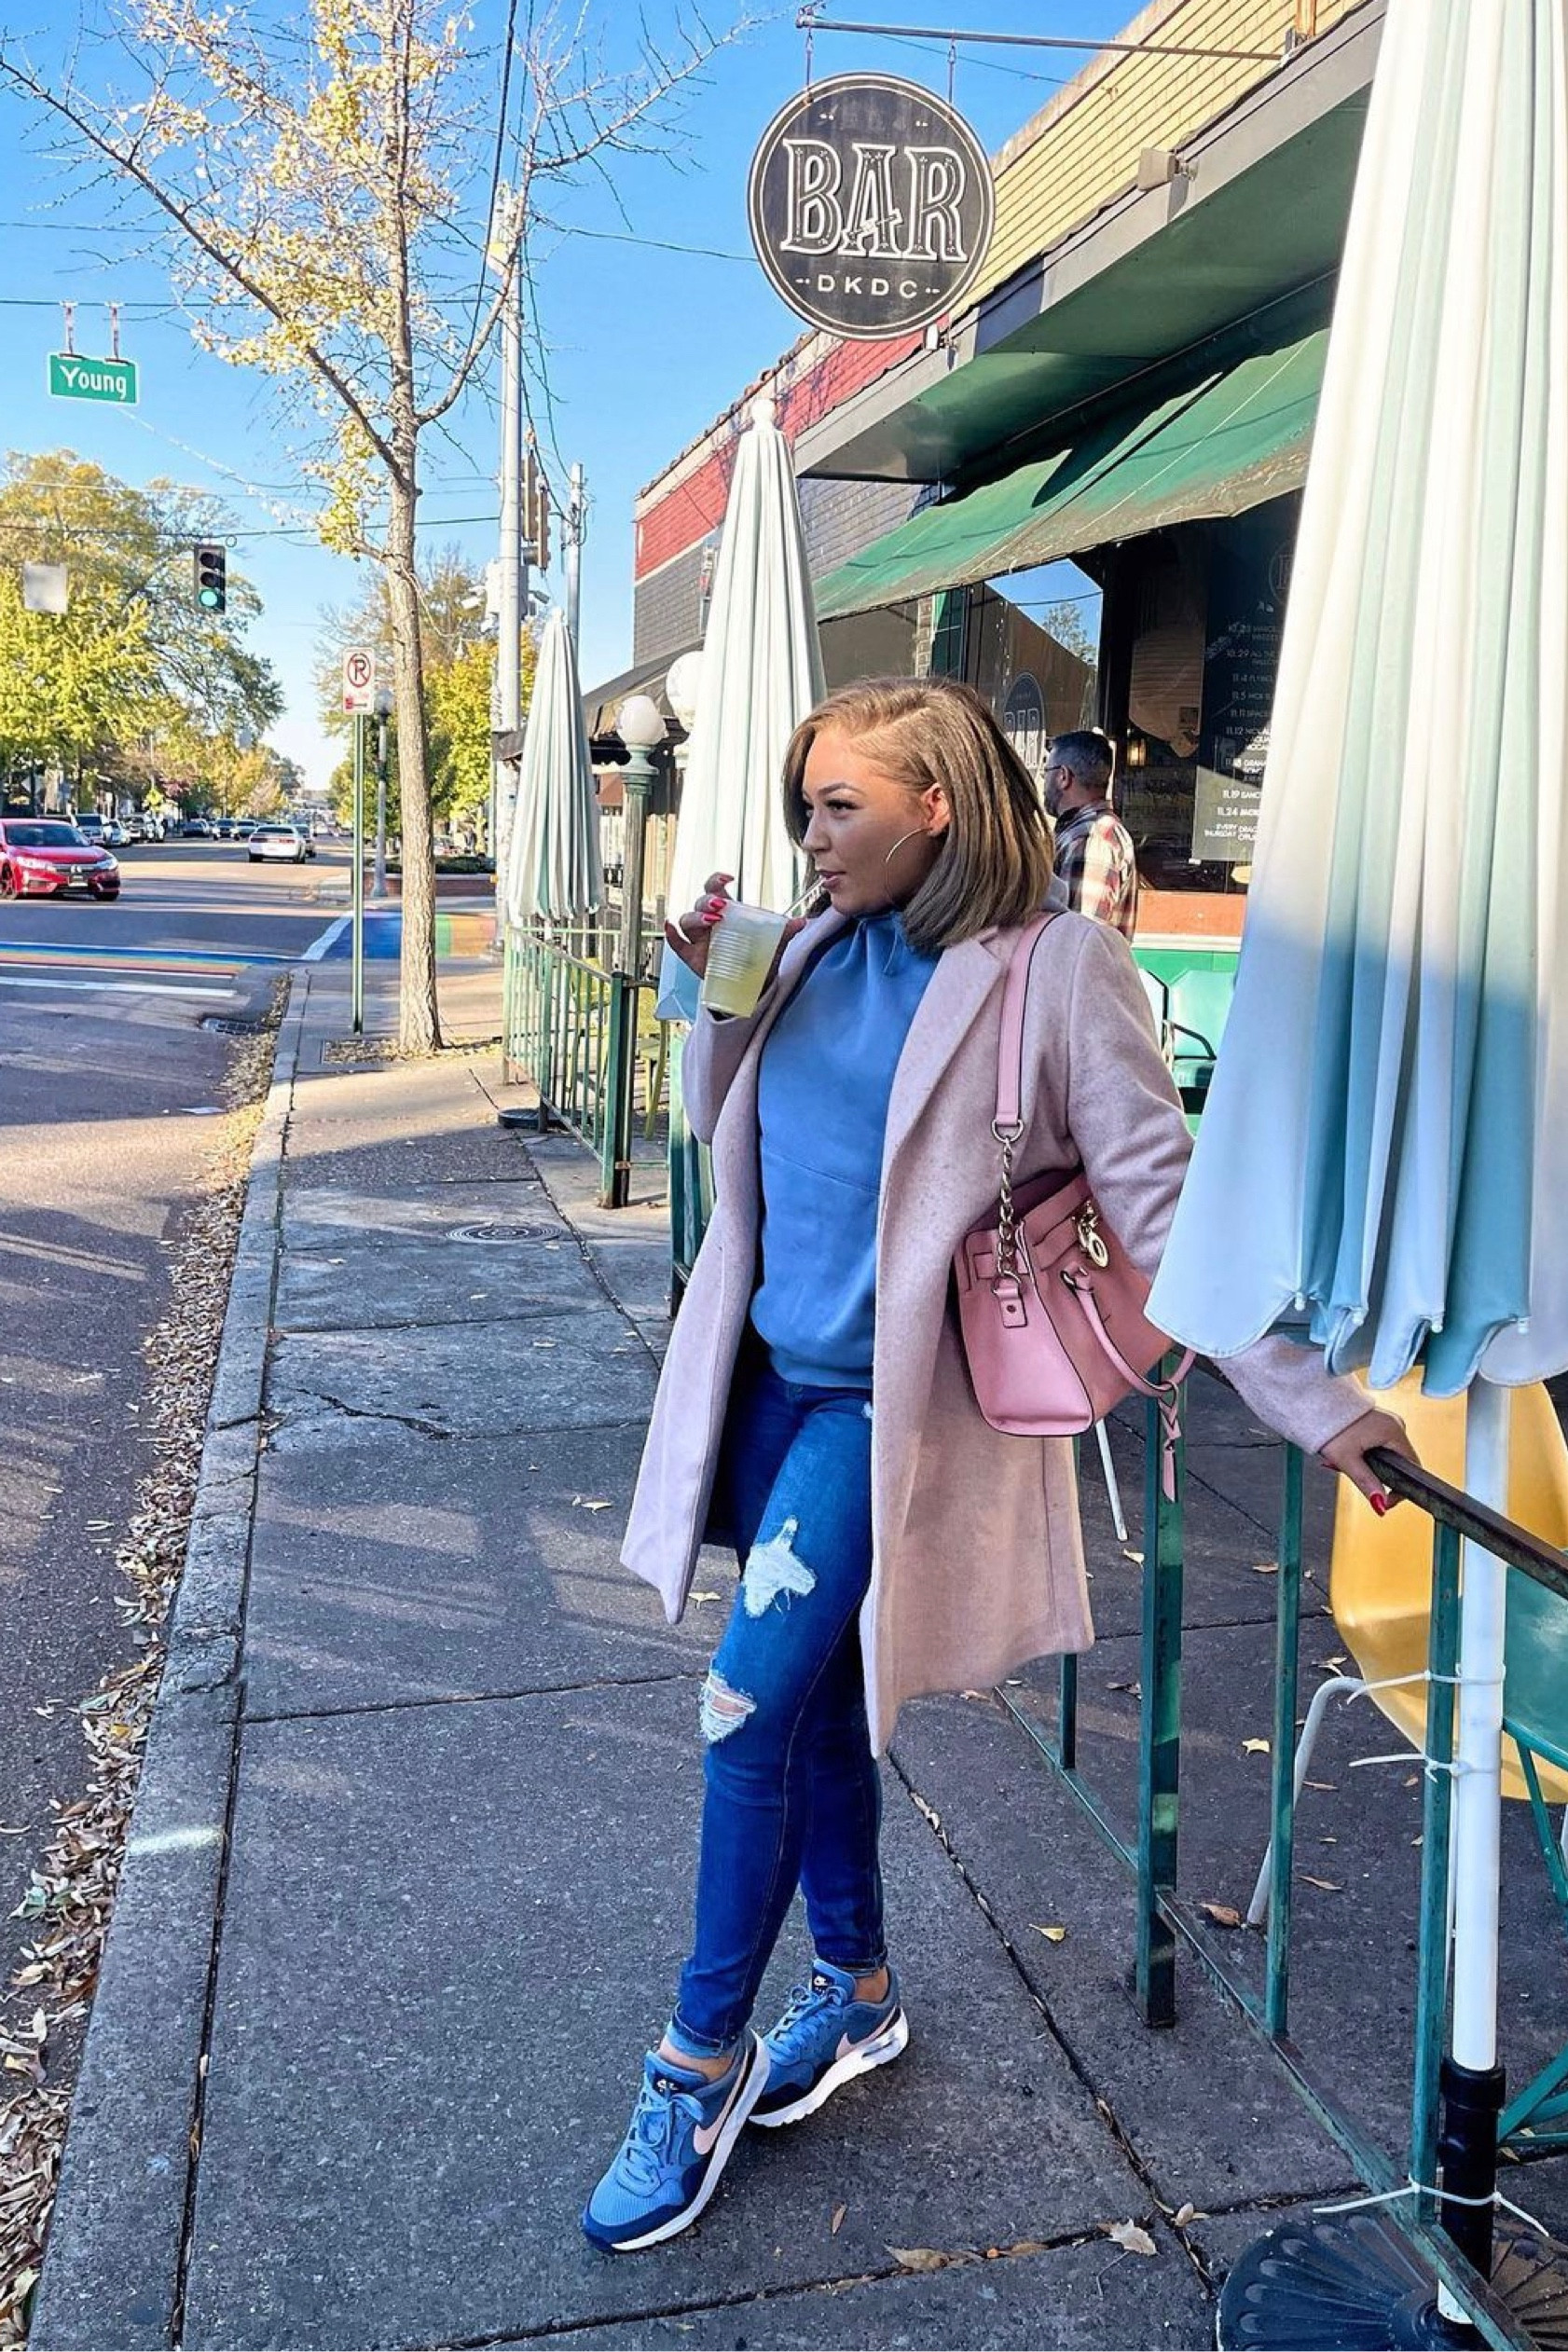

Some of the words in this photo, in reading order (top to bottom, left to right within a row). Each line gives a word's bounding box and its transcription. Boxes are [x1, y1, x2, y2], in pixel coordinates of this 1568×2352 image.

[780, 138, 968, 262] BAR
[818, 274, 918, 299] DKDC
[60, 364, 127, 400] Young
